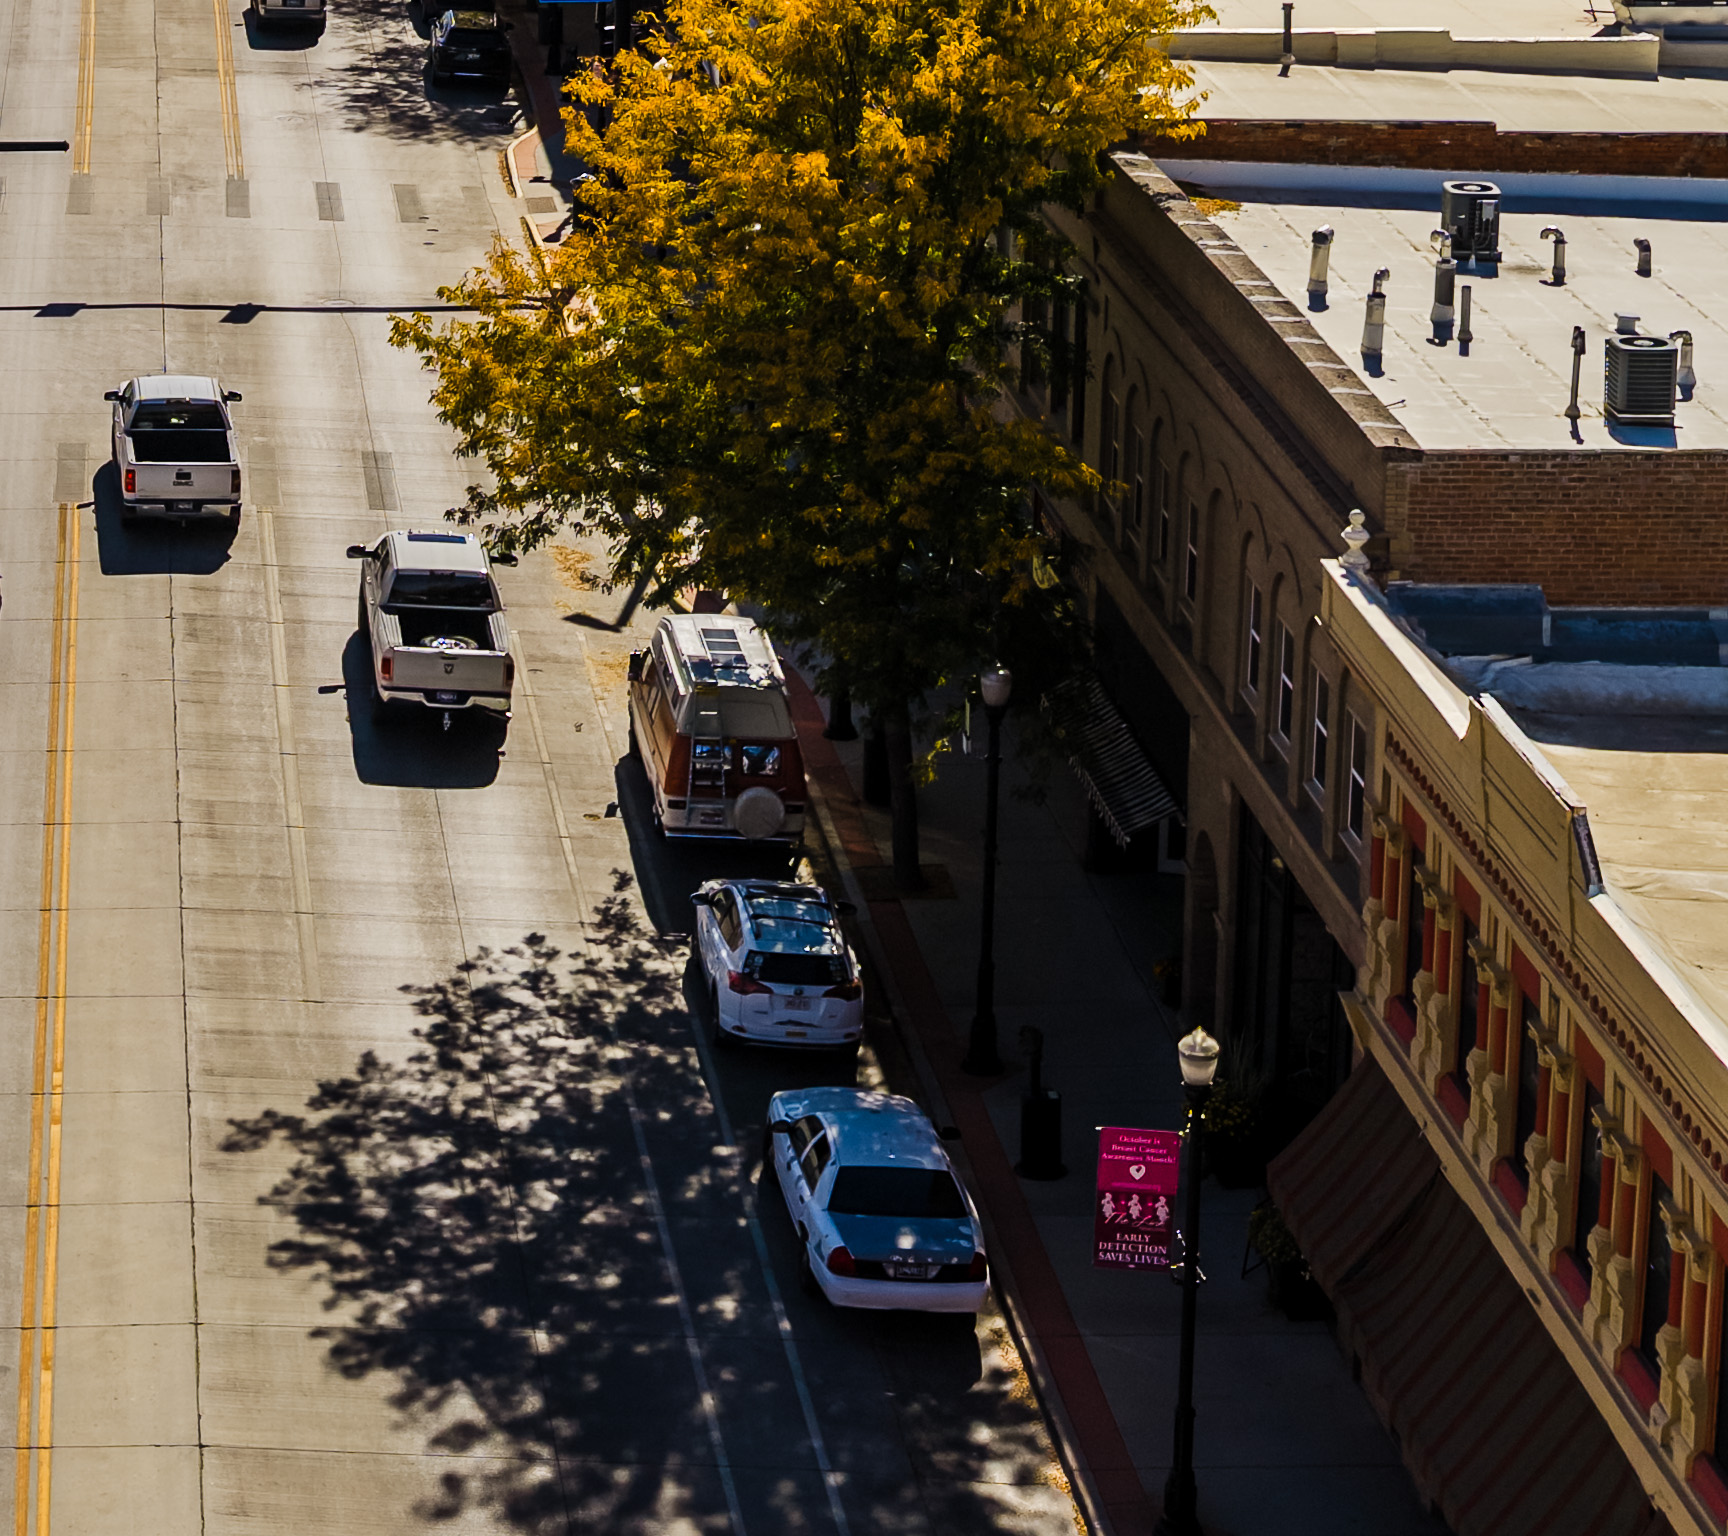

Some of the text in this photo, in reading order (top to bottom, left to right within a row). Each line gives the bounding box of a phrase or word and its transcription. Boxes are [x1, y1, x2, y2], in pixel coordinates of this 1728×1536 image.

[1119, 1135, 1152, 1144] October
[1112, 1144, 1167, 1154] Breast Cancer
[1101, 1152, 1143, 1161] Awareness
[1116, 1232, 1151, 1243] EARLY
[1099, 1241, 1167, 1255] DETECTION
[1098, 1251, 1167, 1266] SAVES LIVES
